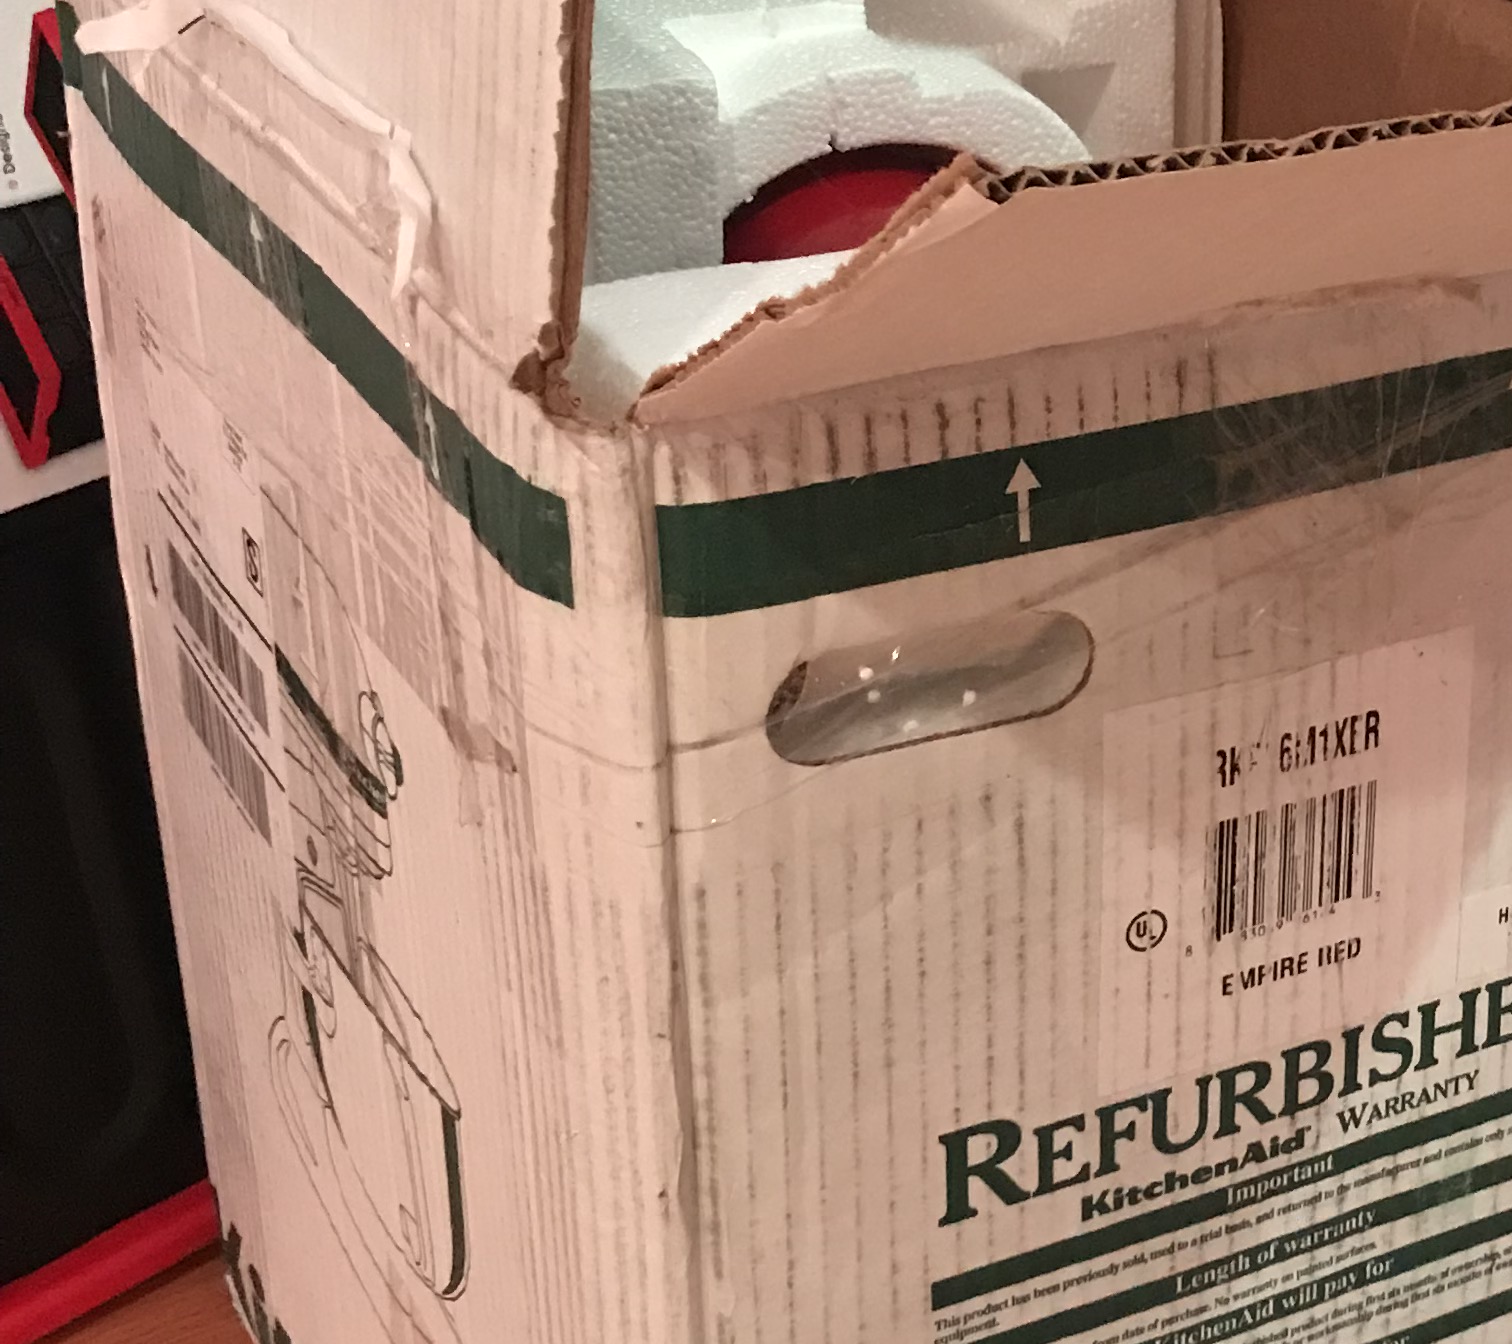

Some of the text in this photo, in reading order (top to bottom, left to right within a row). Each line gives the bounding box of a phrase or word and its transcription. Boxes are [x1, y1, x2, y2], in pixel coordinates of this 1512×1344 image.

[1335, 1069, 1480, 1133] WARRANTY
[1226, 1151, 1334, 1210] Important
[934, 1311, 961, 1337] This
[963, 1295, 1008, 1327] product
[1010, 1287, 1031, 1310] has
[1033, 1277, 1060, 1302] been
[1062, 1257, 1119, 1292] previously
[1121, 1249, 1148, 1272] sold,
[1149, 1240, 1175, 1262] used
[1199, 1223, 1222, 1245] trial
[1255, 1207, 1273, 1225] and
[1276, 1189, 1322, 1217] returned
[1336, 1179, 1351, 1197] the
[1423, 1148, 1442, 1167] and
[1175, 1206, 1376, 1299] Length of warranty
[1121, 1322, 1144, 1342] date
[1147, 1317, 1158, 1332] of
[1214, 1292, 1230, 1309] No
[1232, 1275, 1279, 1303] warranty
[1281, 1280, 1318, 1311] will
[1323, 1269, 1359, 1300] pay
[1364, 1252, 1395, 1280] for
